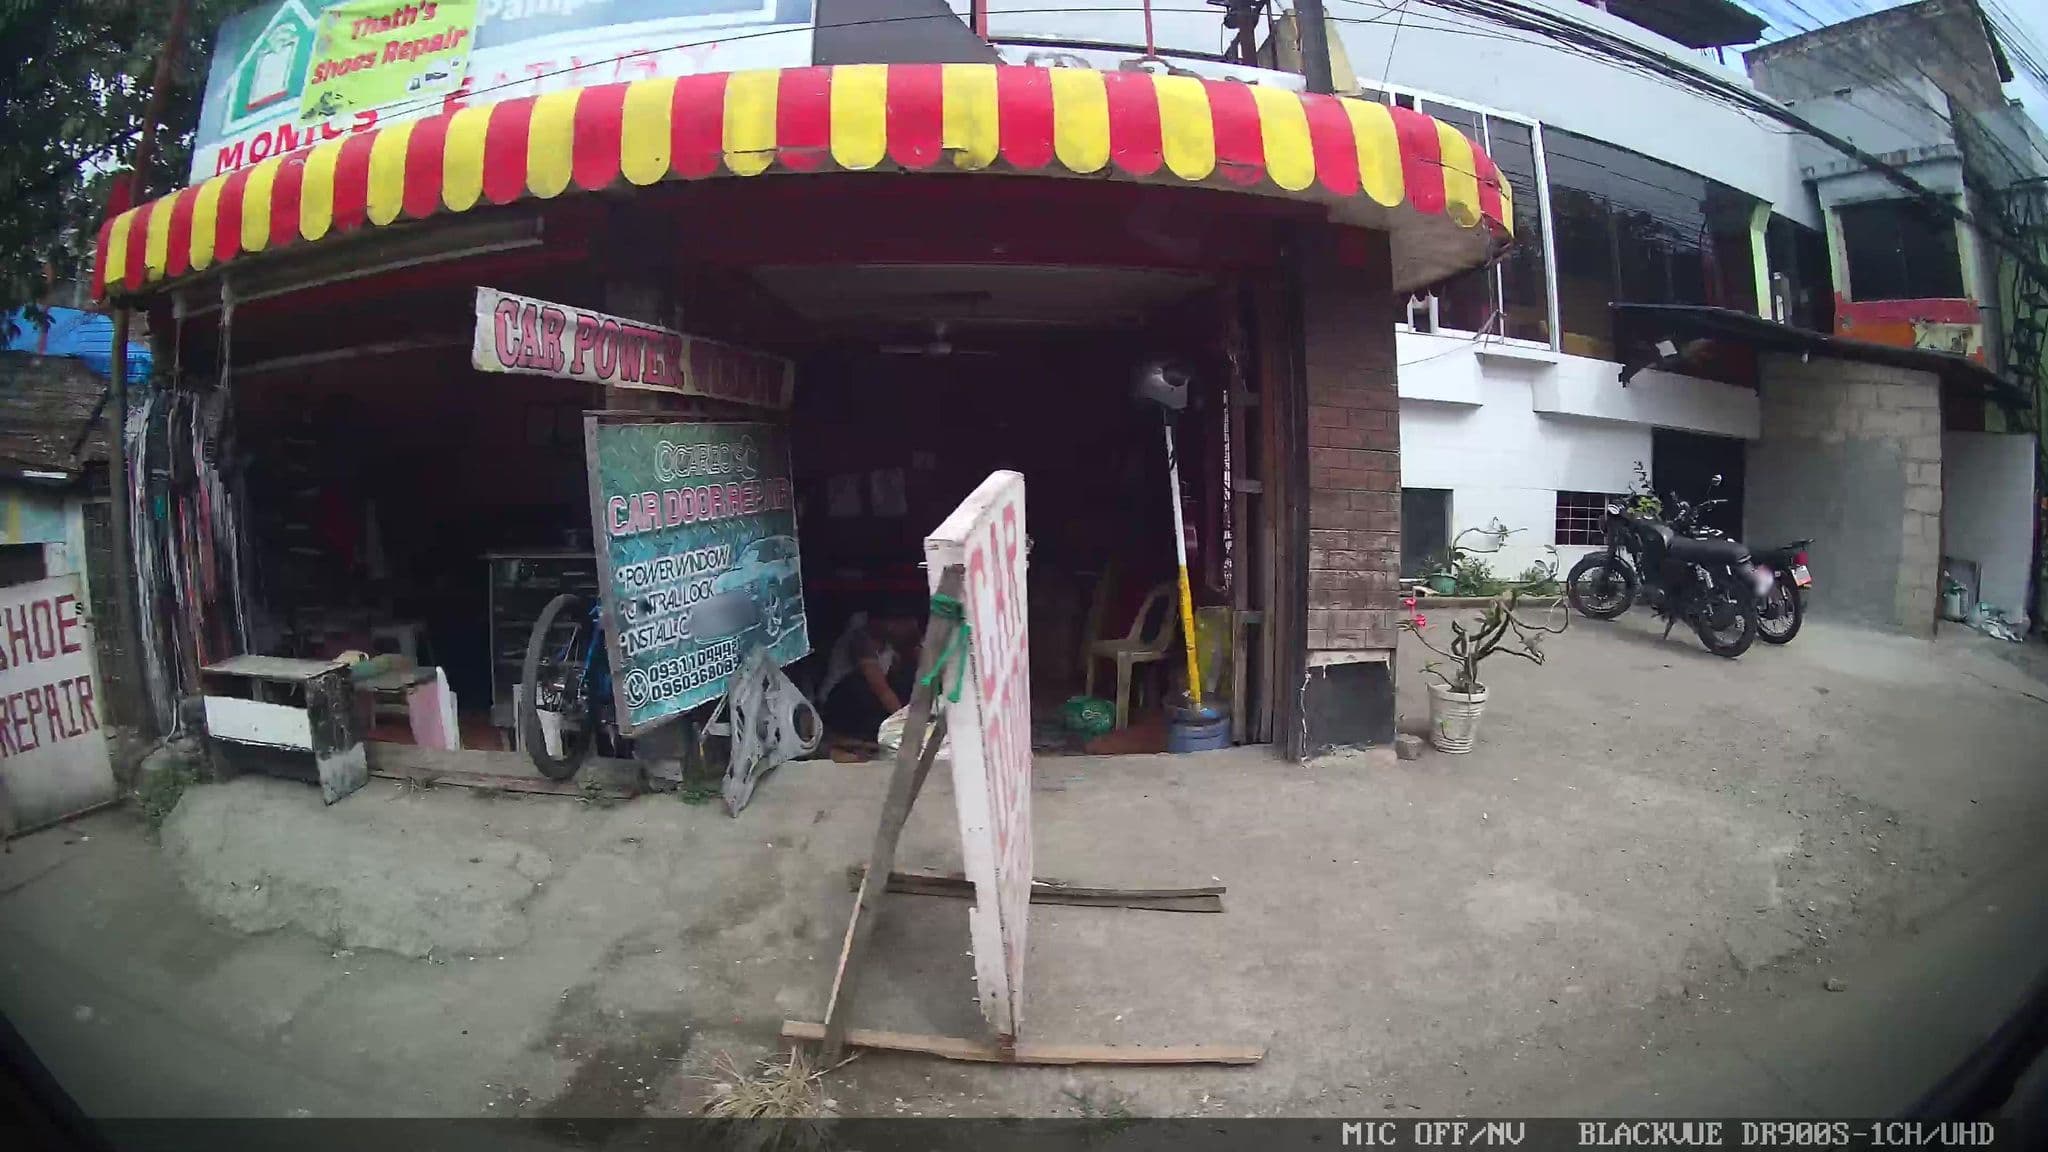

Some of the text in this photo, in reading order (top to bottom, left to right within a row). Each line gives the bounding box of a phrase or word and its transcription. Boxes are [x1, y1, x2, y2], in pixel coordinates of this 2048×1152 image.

[311, 27, 469, 85] Shoes Repair
[494, 297, 566, 373] CAR
[571, 313, 684, 388] POWER
[608, 491, 662, 537] CAR
[661, 483, 726, 527] DOOR
[625, 557, 675, 589] POWER
[683, 579, 715, 606] LOCK
[0, 674, 99, 759] REPAIR
